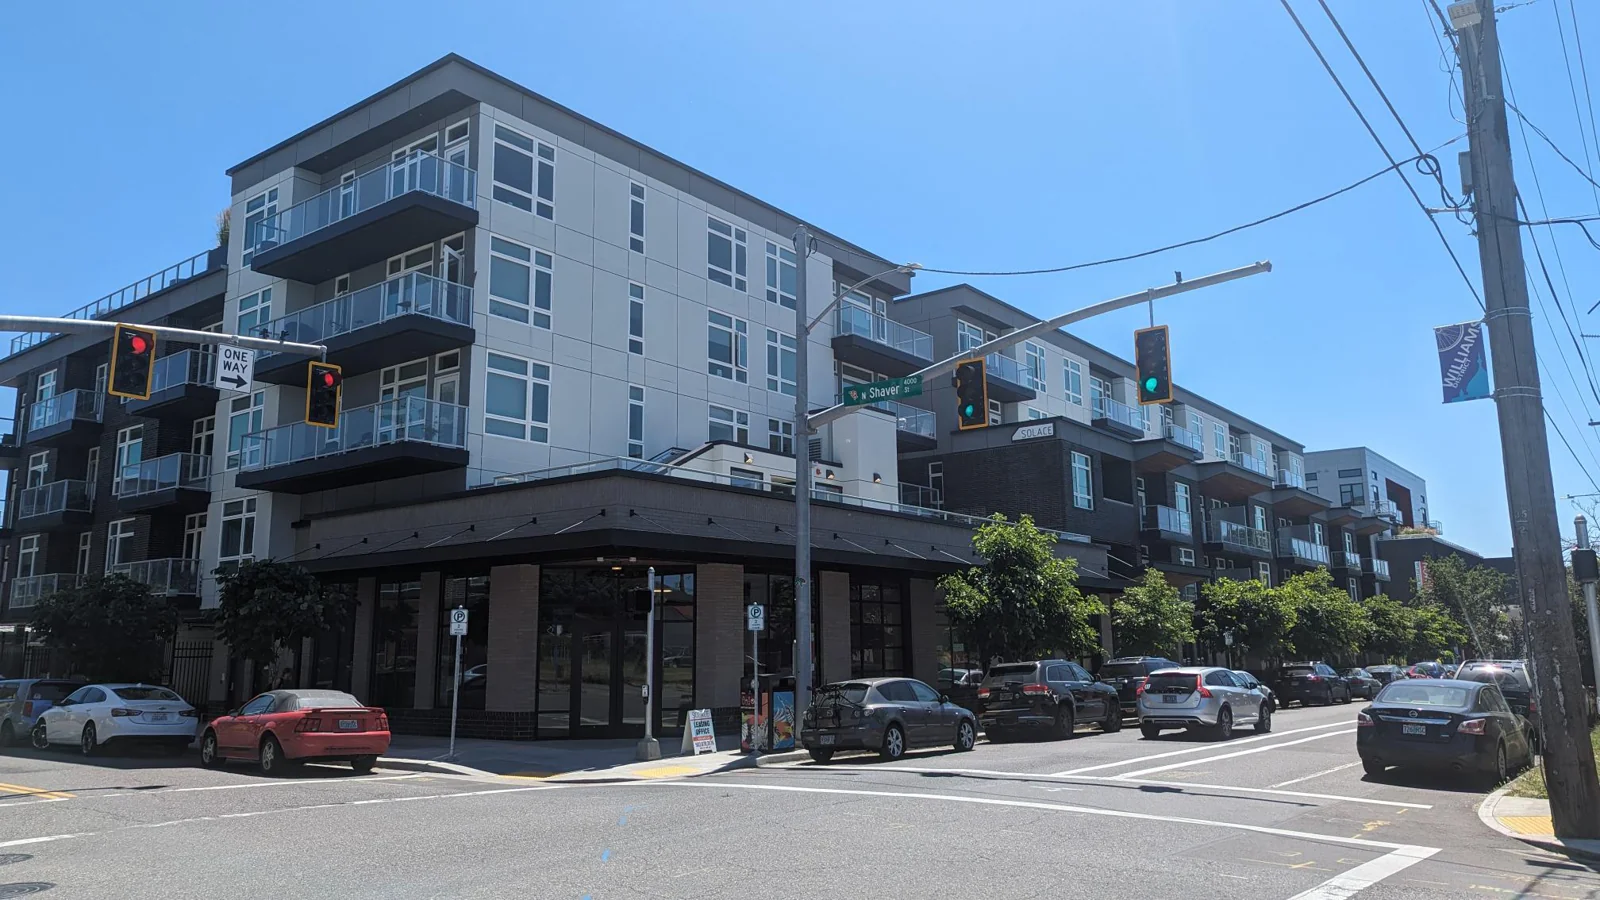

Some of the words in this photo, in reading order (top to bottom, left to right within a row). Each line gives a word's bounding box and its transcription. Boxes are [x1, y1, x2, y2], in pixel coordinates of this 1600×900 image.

[224, 348, 248, 363] ONE
[1442, 322, 1481, 388] WILLIAMS
[223, 360, 248, 374] WAY
[1452, 358, 1471, 389] DISTRICT
[903, 377, 918, 385] 4000
[861, 391, 867, 400] N
[869, 385, 900, 399] Shaver
[904, 386, 910, 394] St
[1020, 426, 1052, 439] SOLACE
[695, 728, 710, 736] OFFICE
